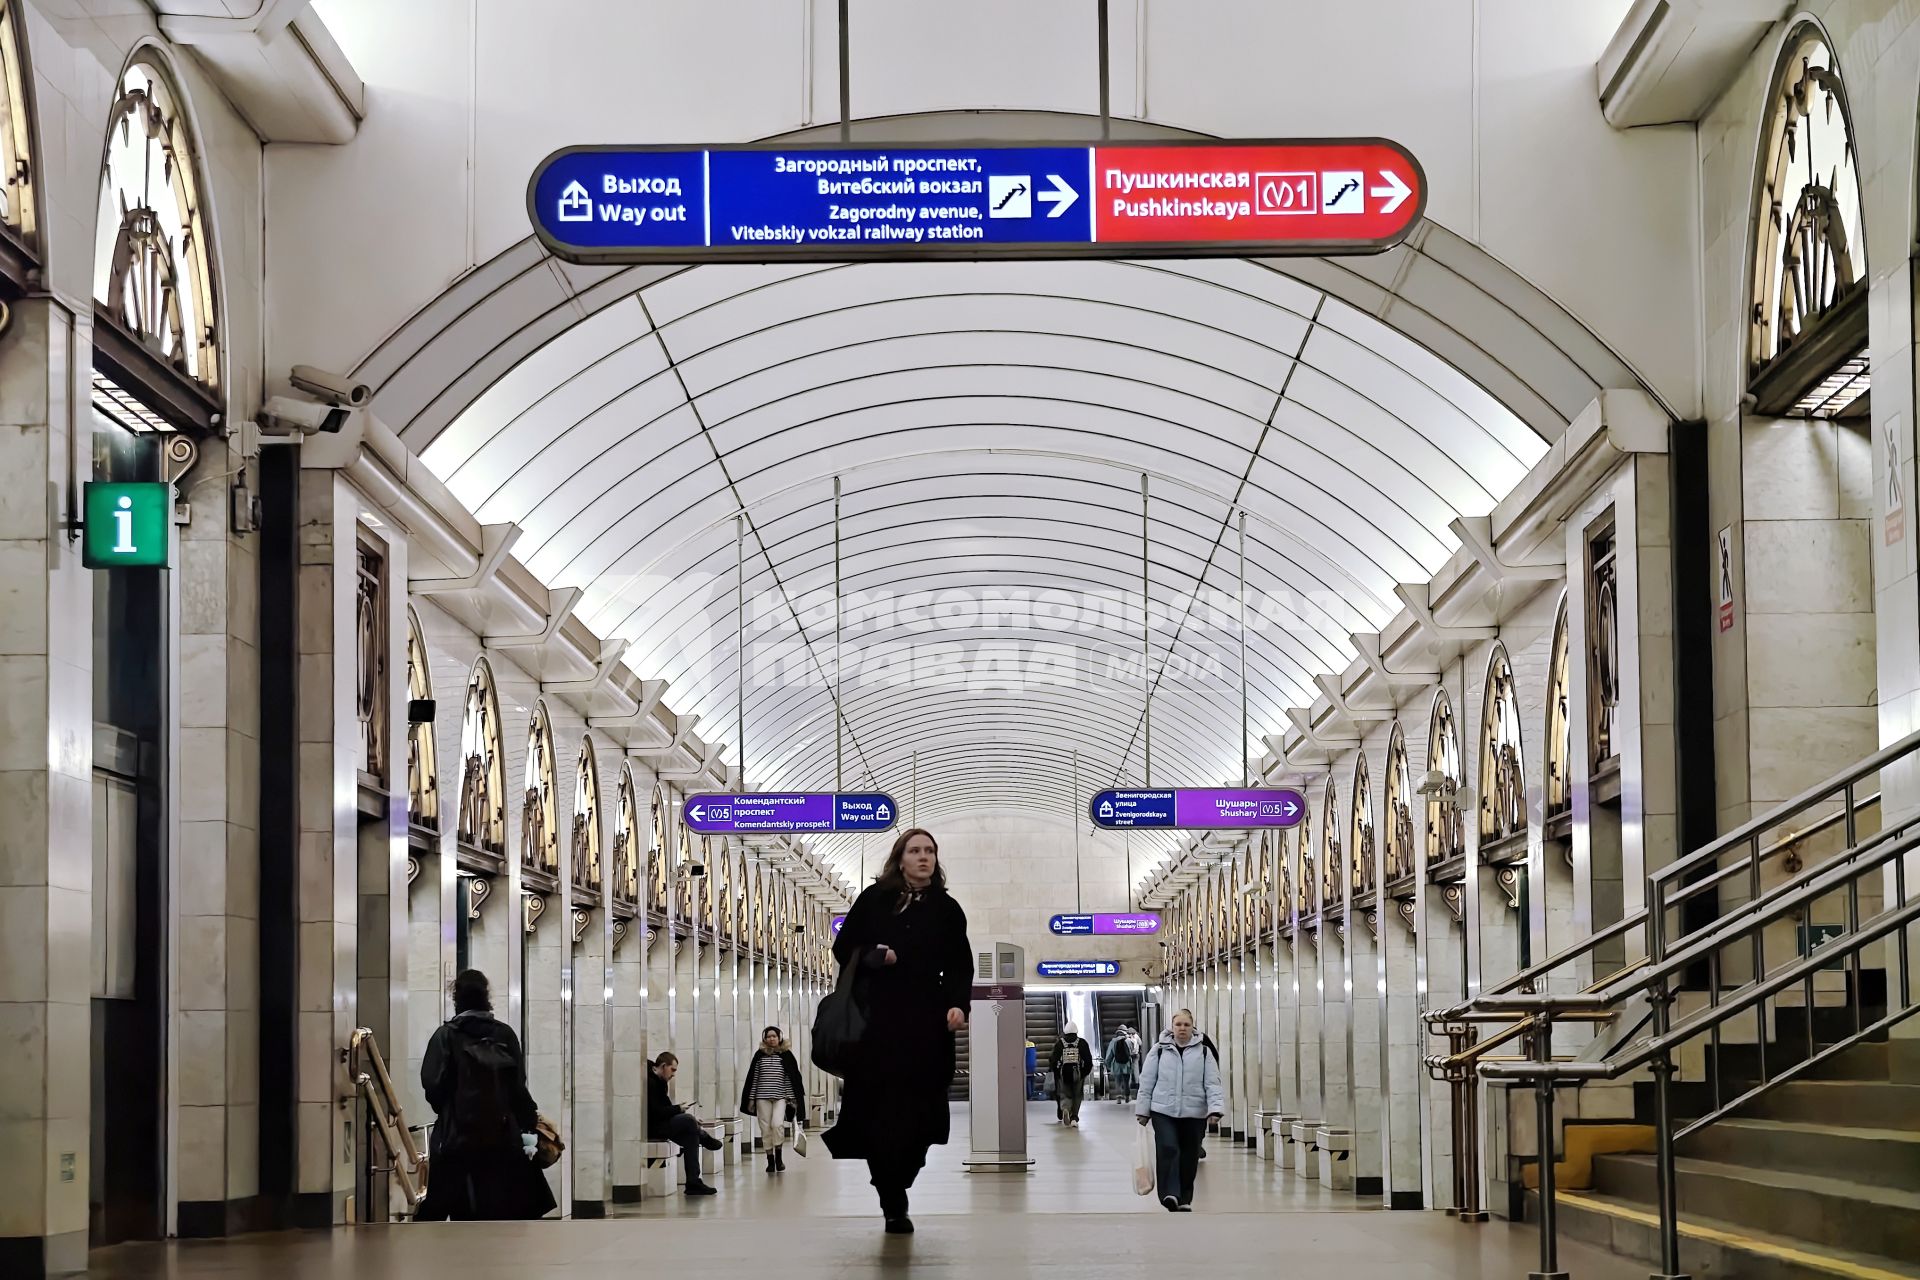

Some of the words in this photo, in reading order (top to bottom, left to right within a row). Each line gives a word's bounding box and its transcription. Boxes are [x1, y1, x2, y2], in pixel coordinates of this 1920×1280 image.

[776, 156, 888, 175] Загородный
[893, 159, 981, 175] проспект,
[604, 175, 681, 196] Выход
[818, 178, 915, 194] Витебский
[919, 181, 982, 193] вокзал
[1106, 169, 1249, 193] Пушкинская
[599, 204, 646, 225] Way
[651, 205, 686, 221] out
[830, 204, 916, 222] Zagorodny
[919, 207, 982, 219] avenue,
[1114, 197, 1250, 220] Pushkinskaya
[732, 225, 805, 243] Vitebskiy
[808, 224, 860, 239] vokzal
[865, 224, 924, 242] railway
[928, 224, 983, 238] station
[735, 797, 805, 805] Комендантский
[843, 802, 872, 810] Выход
[1216, 800, 1257, 809] Шушары
[841, 814, 859, 822] Way
[1221, 810, 1257, 818] Shushary
[735, 821, 794, 829] Komendantskiy
[796, 820, 830, 829] prospekt
